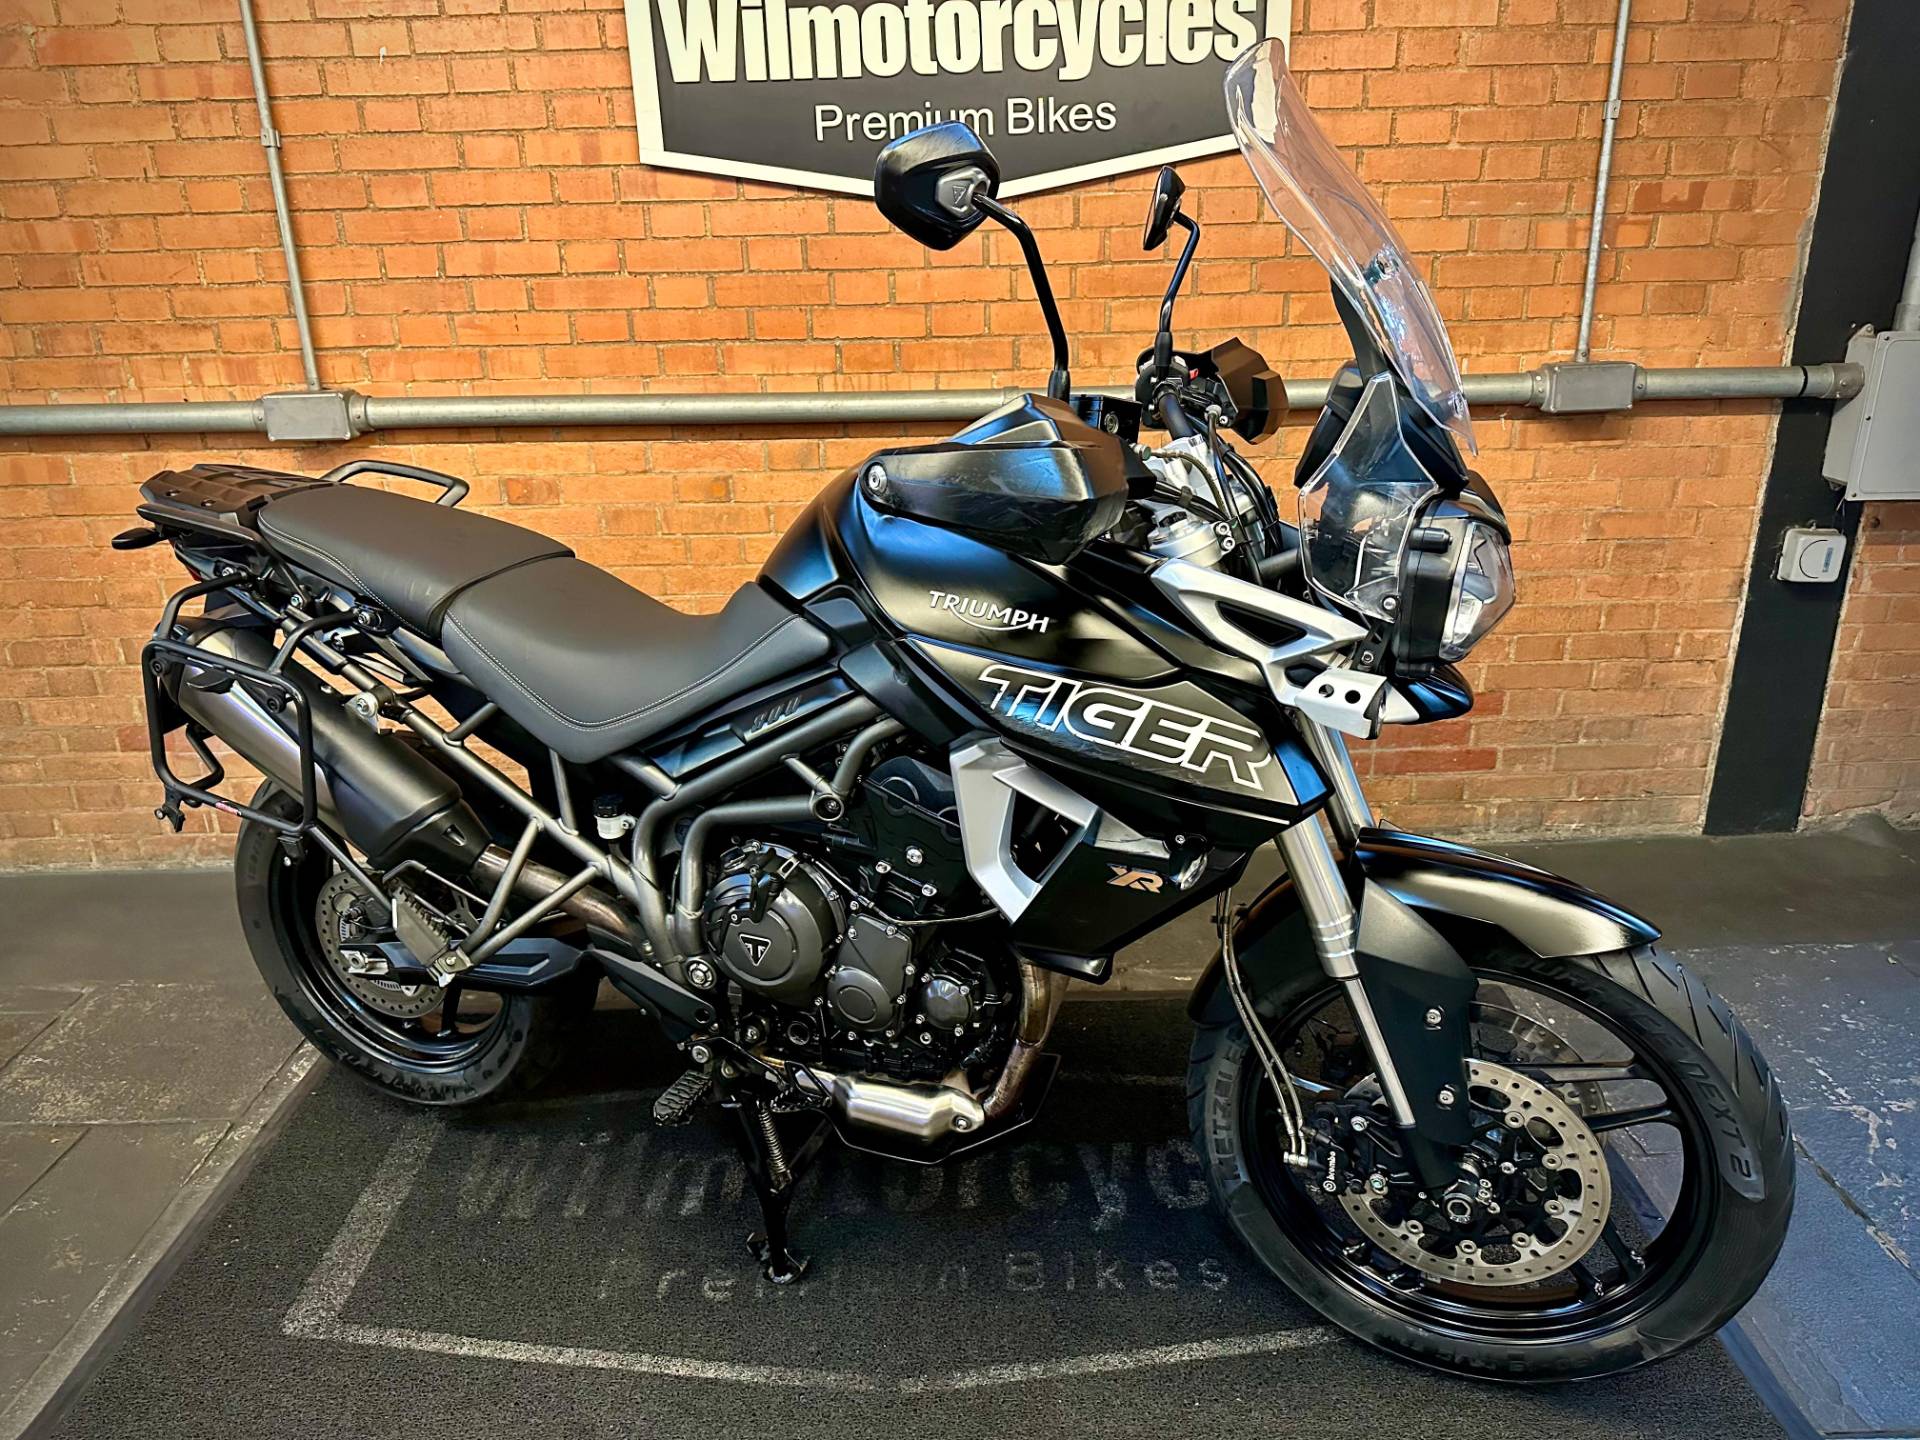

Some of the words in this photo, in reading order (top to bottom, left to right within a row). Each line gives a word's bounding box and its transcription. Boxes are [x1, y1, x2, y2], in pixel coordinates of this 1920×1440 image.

[656, 0, 1257, 83] Wilmotorcycles
[928, 590, 1050, 634] TRIUMPH
[978, 664, 1273, 792] TIGER
[1106, 862, 1164, 894] XR
